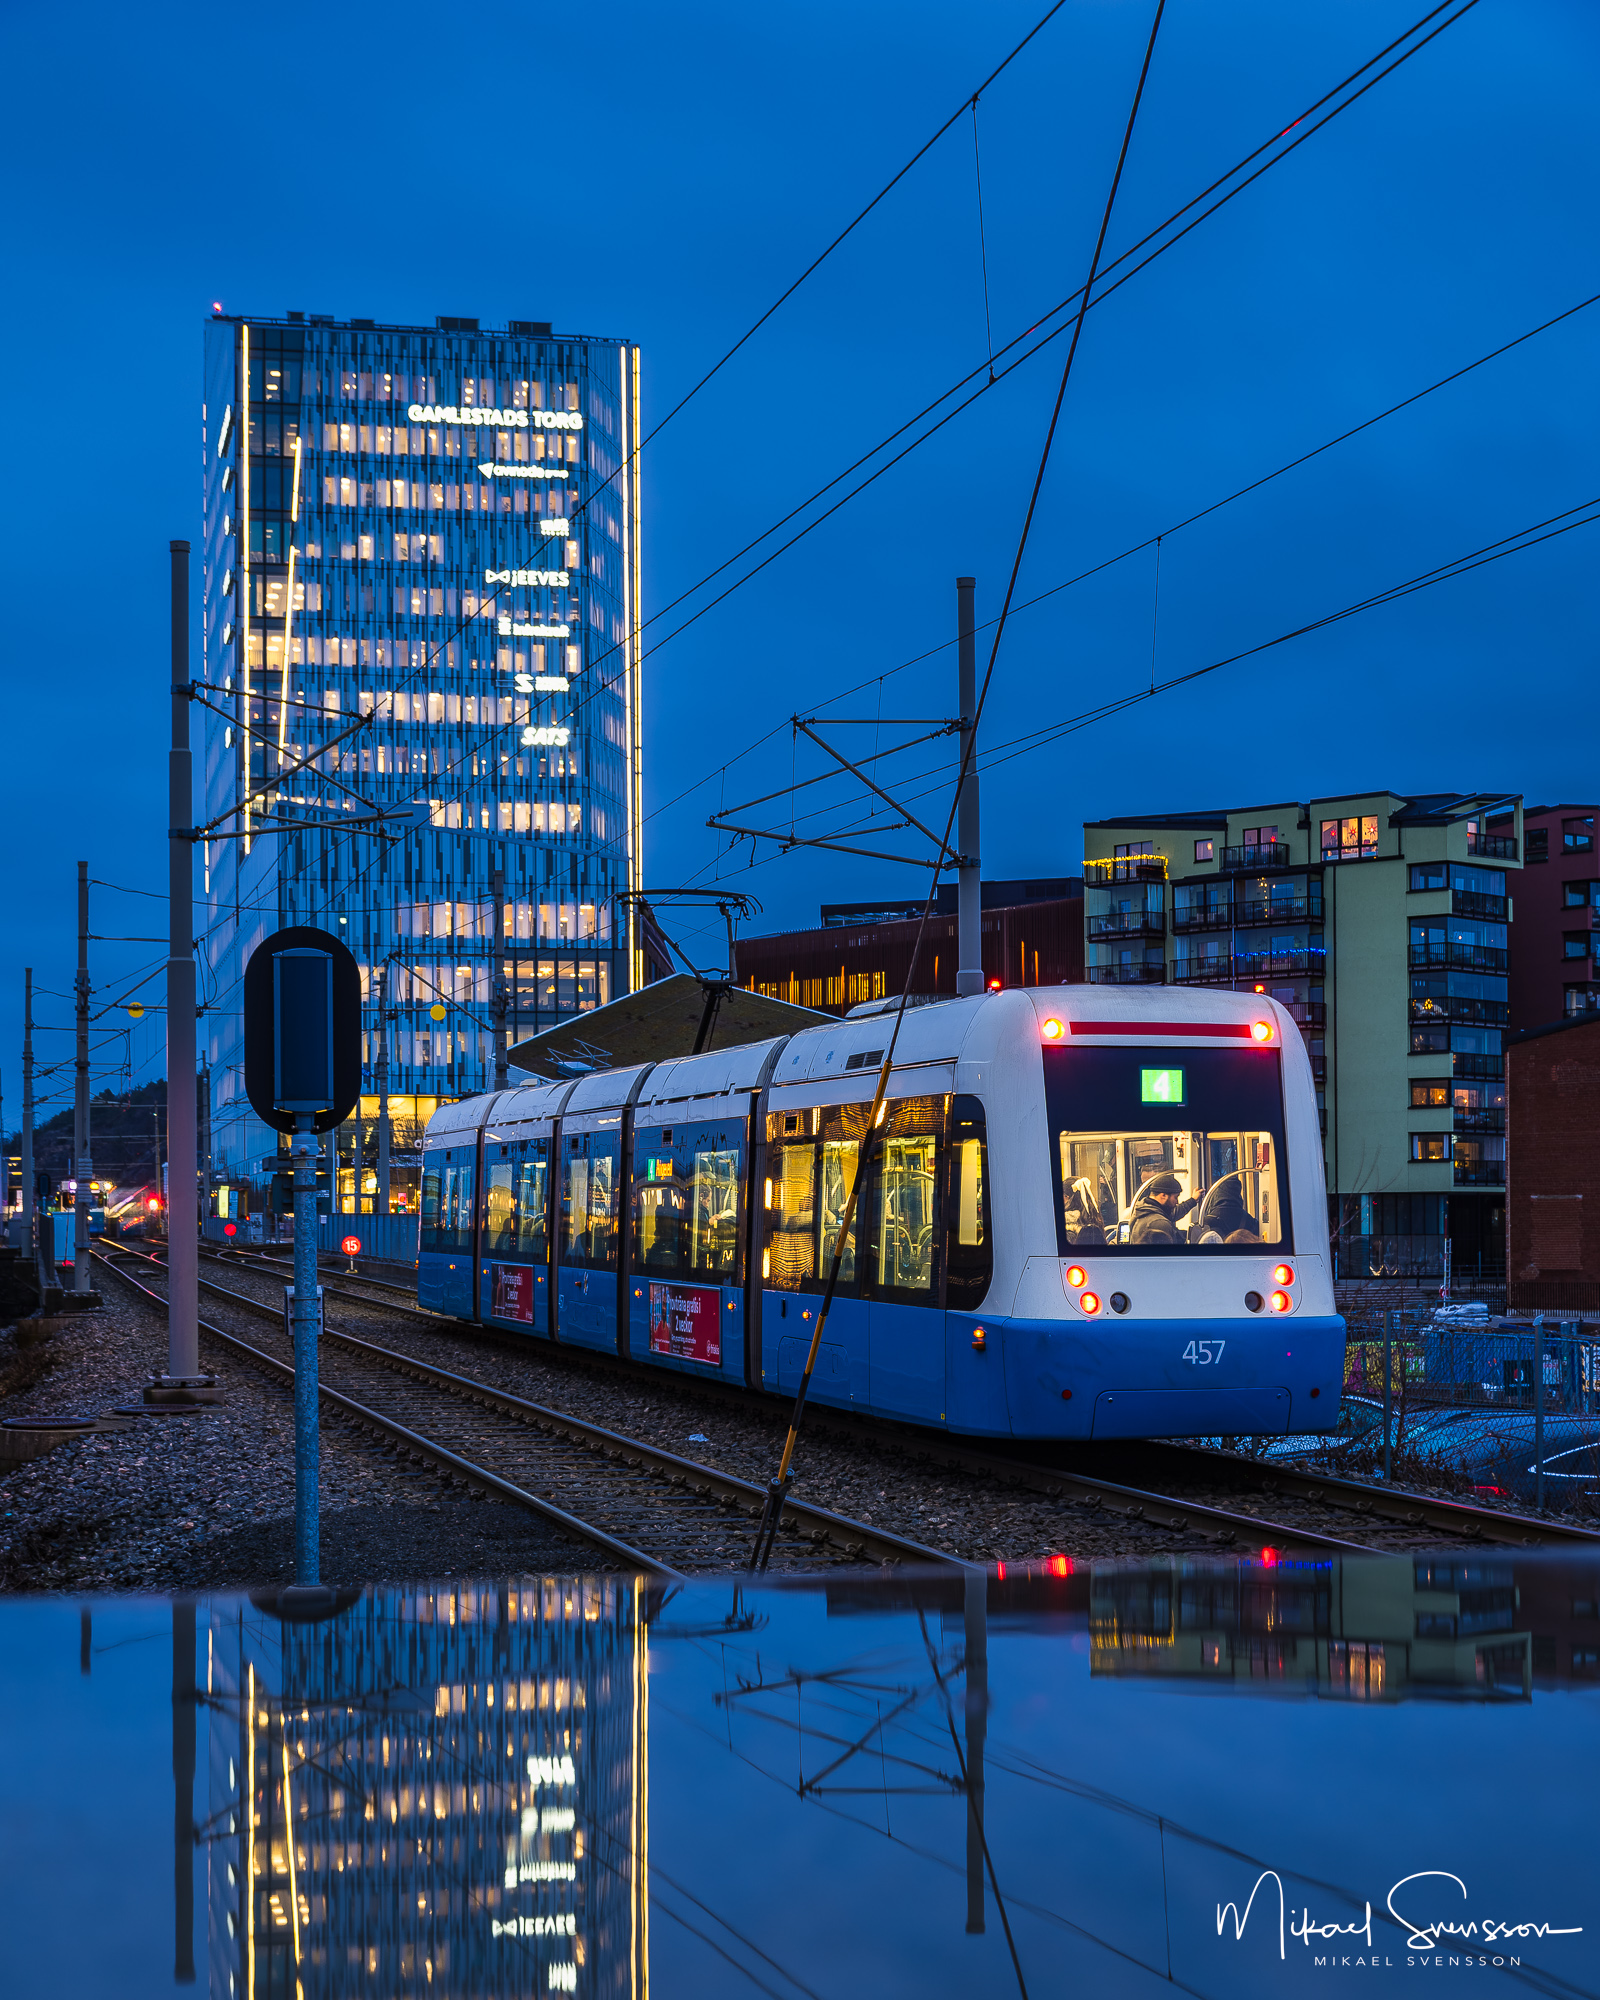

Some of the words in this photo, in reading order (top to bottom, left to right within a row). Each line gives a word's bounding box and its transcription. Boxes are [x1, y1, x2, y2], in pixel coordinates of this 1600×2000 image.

[408, 405, 529, 427] GAMLESTADS
[532, 411, 583, 430] TORG
[521, 727, 570, 746] SATS
[1154, 1071, 1169, 1100] 4
[345, 1240, 358, 1252] 15
[1182, 1340, 1226, 1365] 457
